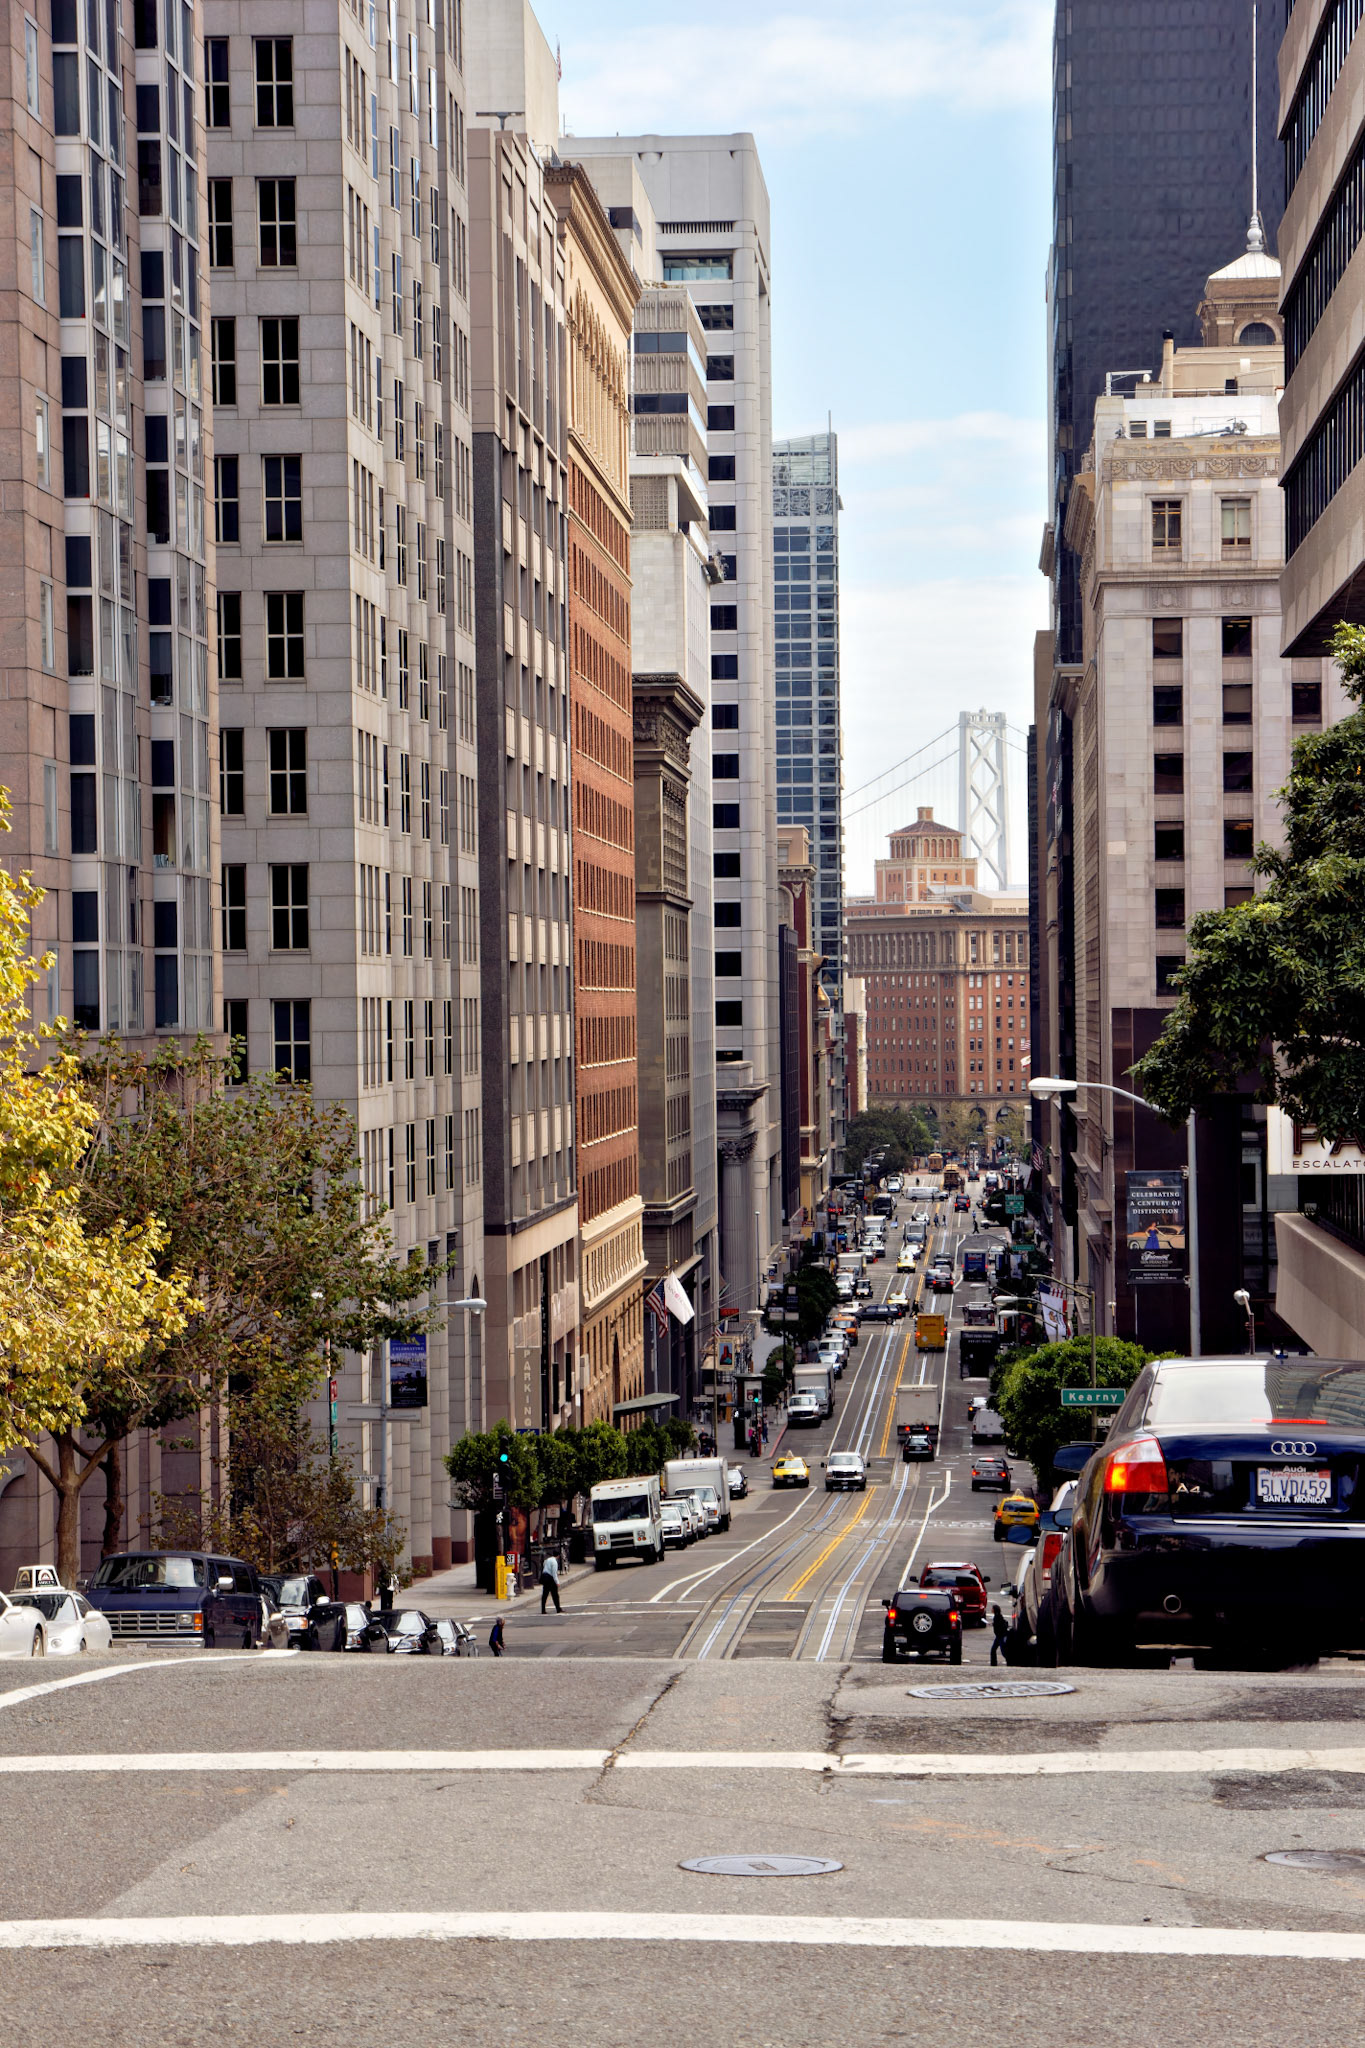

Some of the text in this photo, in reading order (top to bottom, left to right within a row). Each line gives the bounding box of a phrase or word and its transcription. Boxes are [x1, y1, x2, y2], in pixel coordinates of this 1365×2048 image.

[1292, 1160, 1365, 1168] ESCALAT
[523, 1349, 532, 1427] PARKING
[1069, 1392, 1118, 1403] Kearny
[1176, 1482, 1201, 1494] A4
[1261, 1479, 1328, 1498] 5LVD459
[1262, 1495, 1327, 1504] SANTA MONICA
